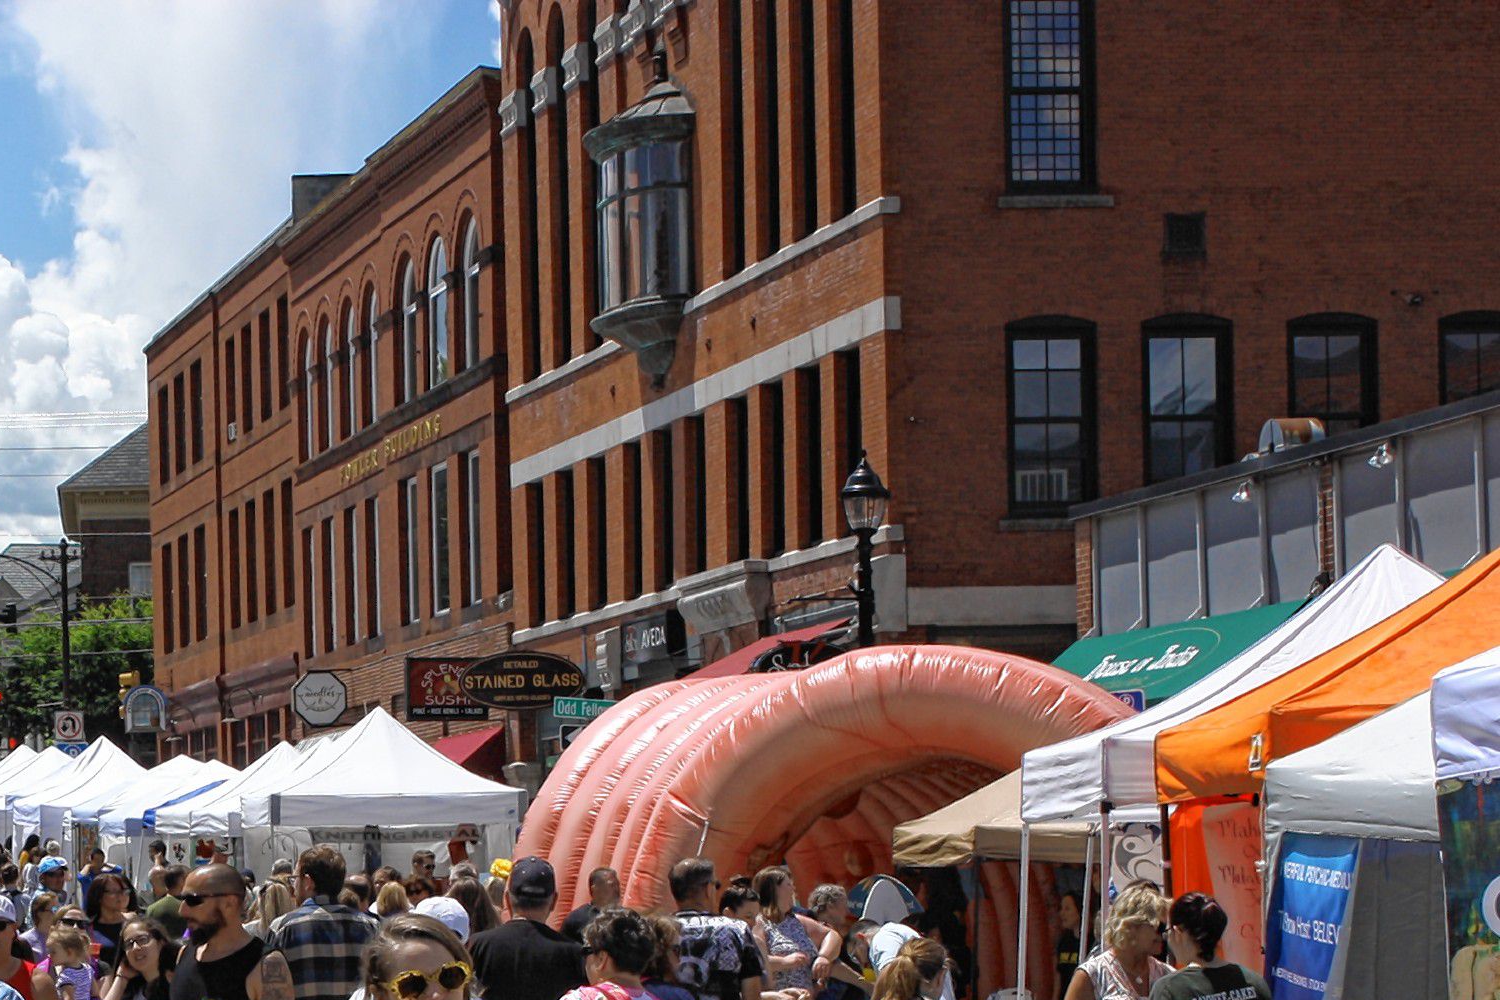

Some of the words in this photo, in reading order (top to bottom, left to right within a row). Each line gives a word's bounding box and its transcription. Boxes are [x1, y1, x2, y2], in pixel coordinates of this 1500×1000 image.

[383, 413, 442, 461] BUILDING
[640, 625, 667, 650] AVEDA
[502, 660, 539, 669] DETAILED
[464, 674, 526, 690] STAINED
[532, 673, 581, 687] GLASS
[304, 685, 336, 698] noodles
[424, 694, 472, 706] SUSHI
[556, 700, 578, 715] Odd
[313, 830, 408, 842] KNITTING
[411, 828, 481, 840] METAL
